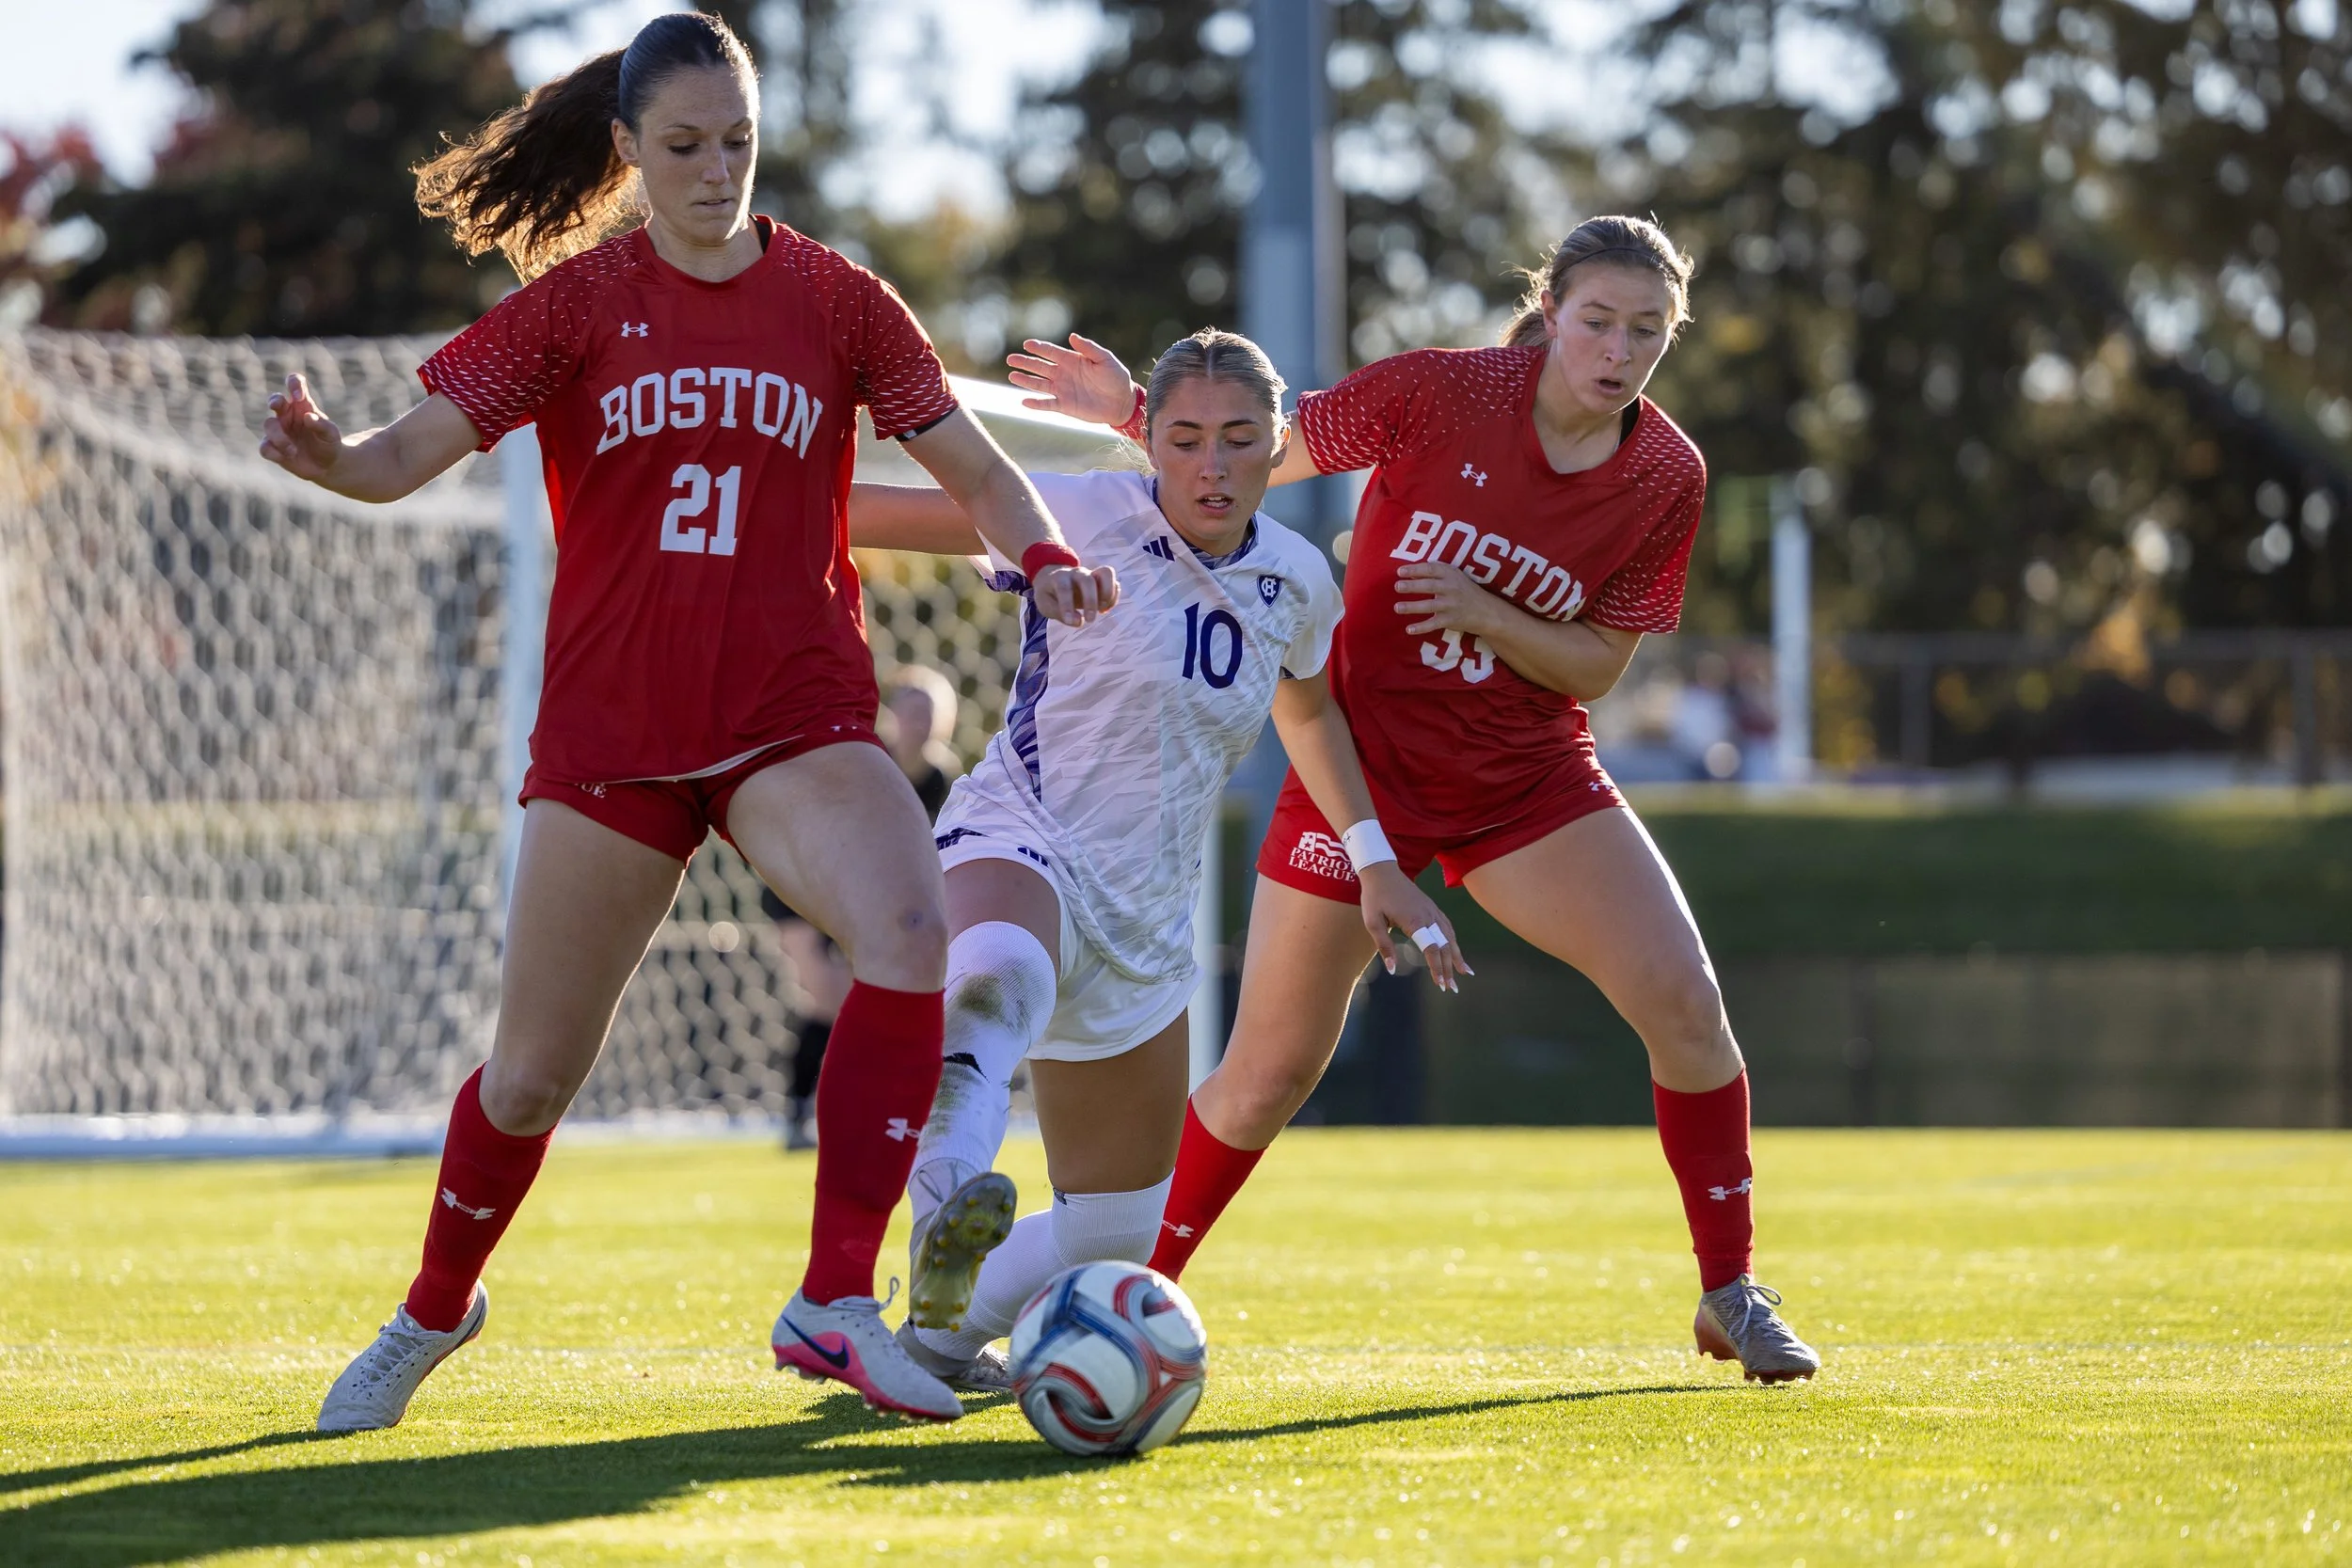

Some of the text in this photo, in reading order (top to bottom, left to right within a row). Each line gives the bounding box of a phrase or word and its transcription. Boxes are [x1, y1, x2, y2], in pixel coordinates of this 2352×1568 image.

[596, 367, 824, 460] BOSTON
[660, 464, 742, 556] 21
[1390, 511, 1587, 623] BOSTON
[1182, 602, 1244, 689] 10
[1288, 856, 1356, 882] LEAGUE
